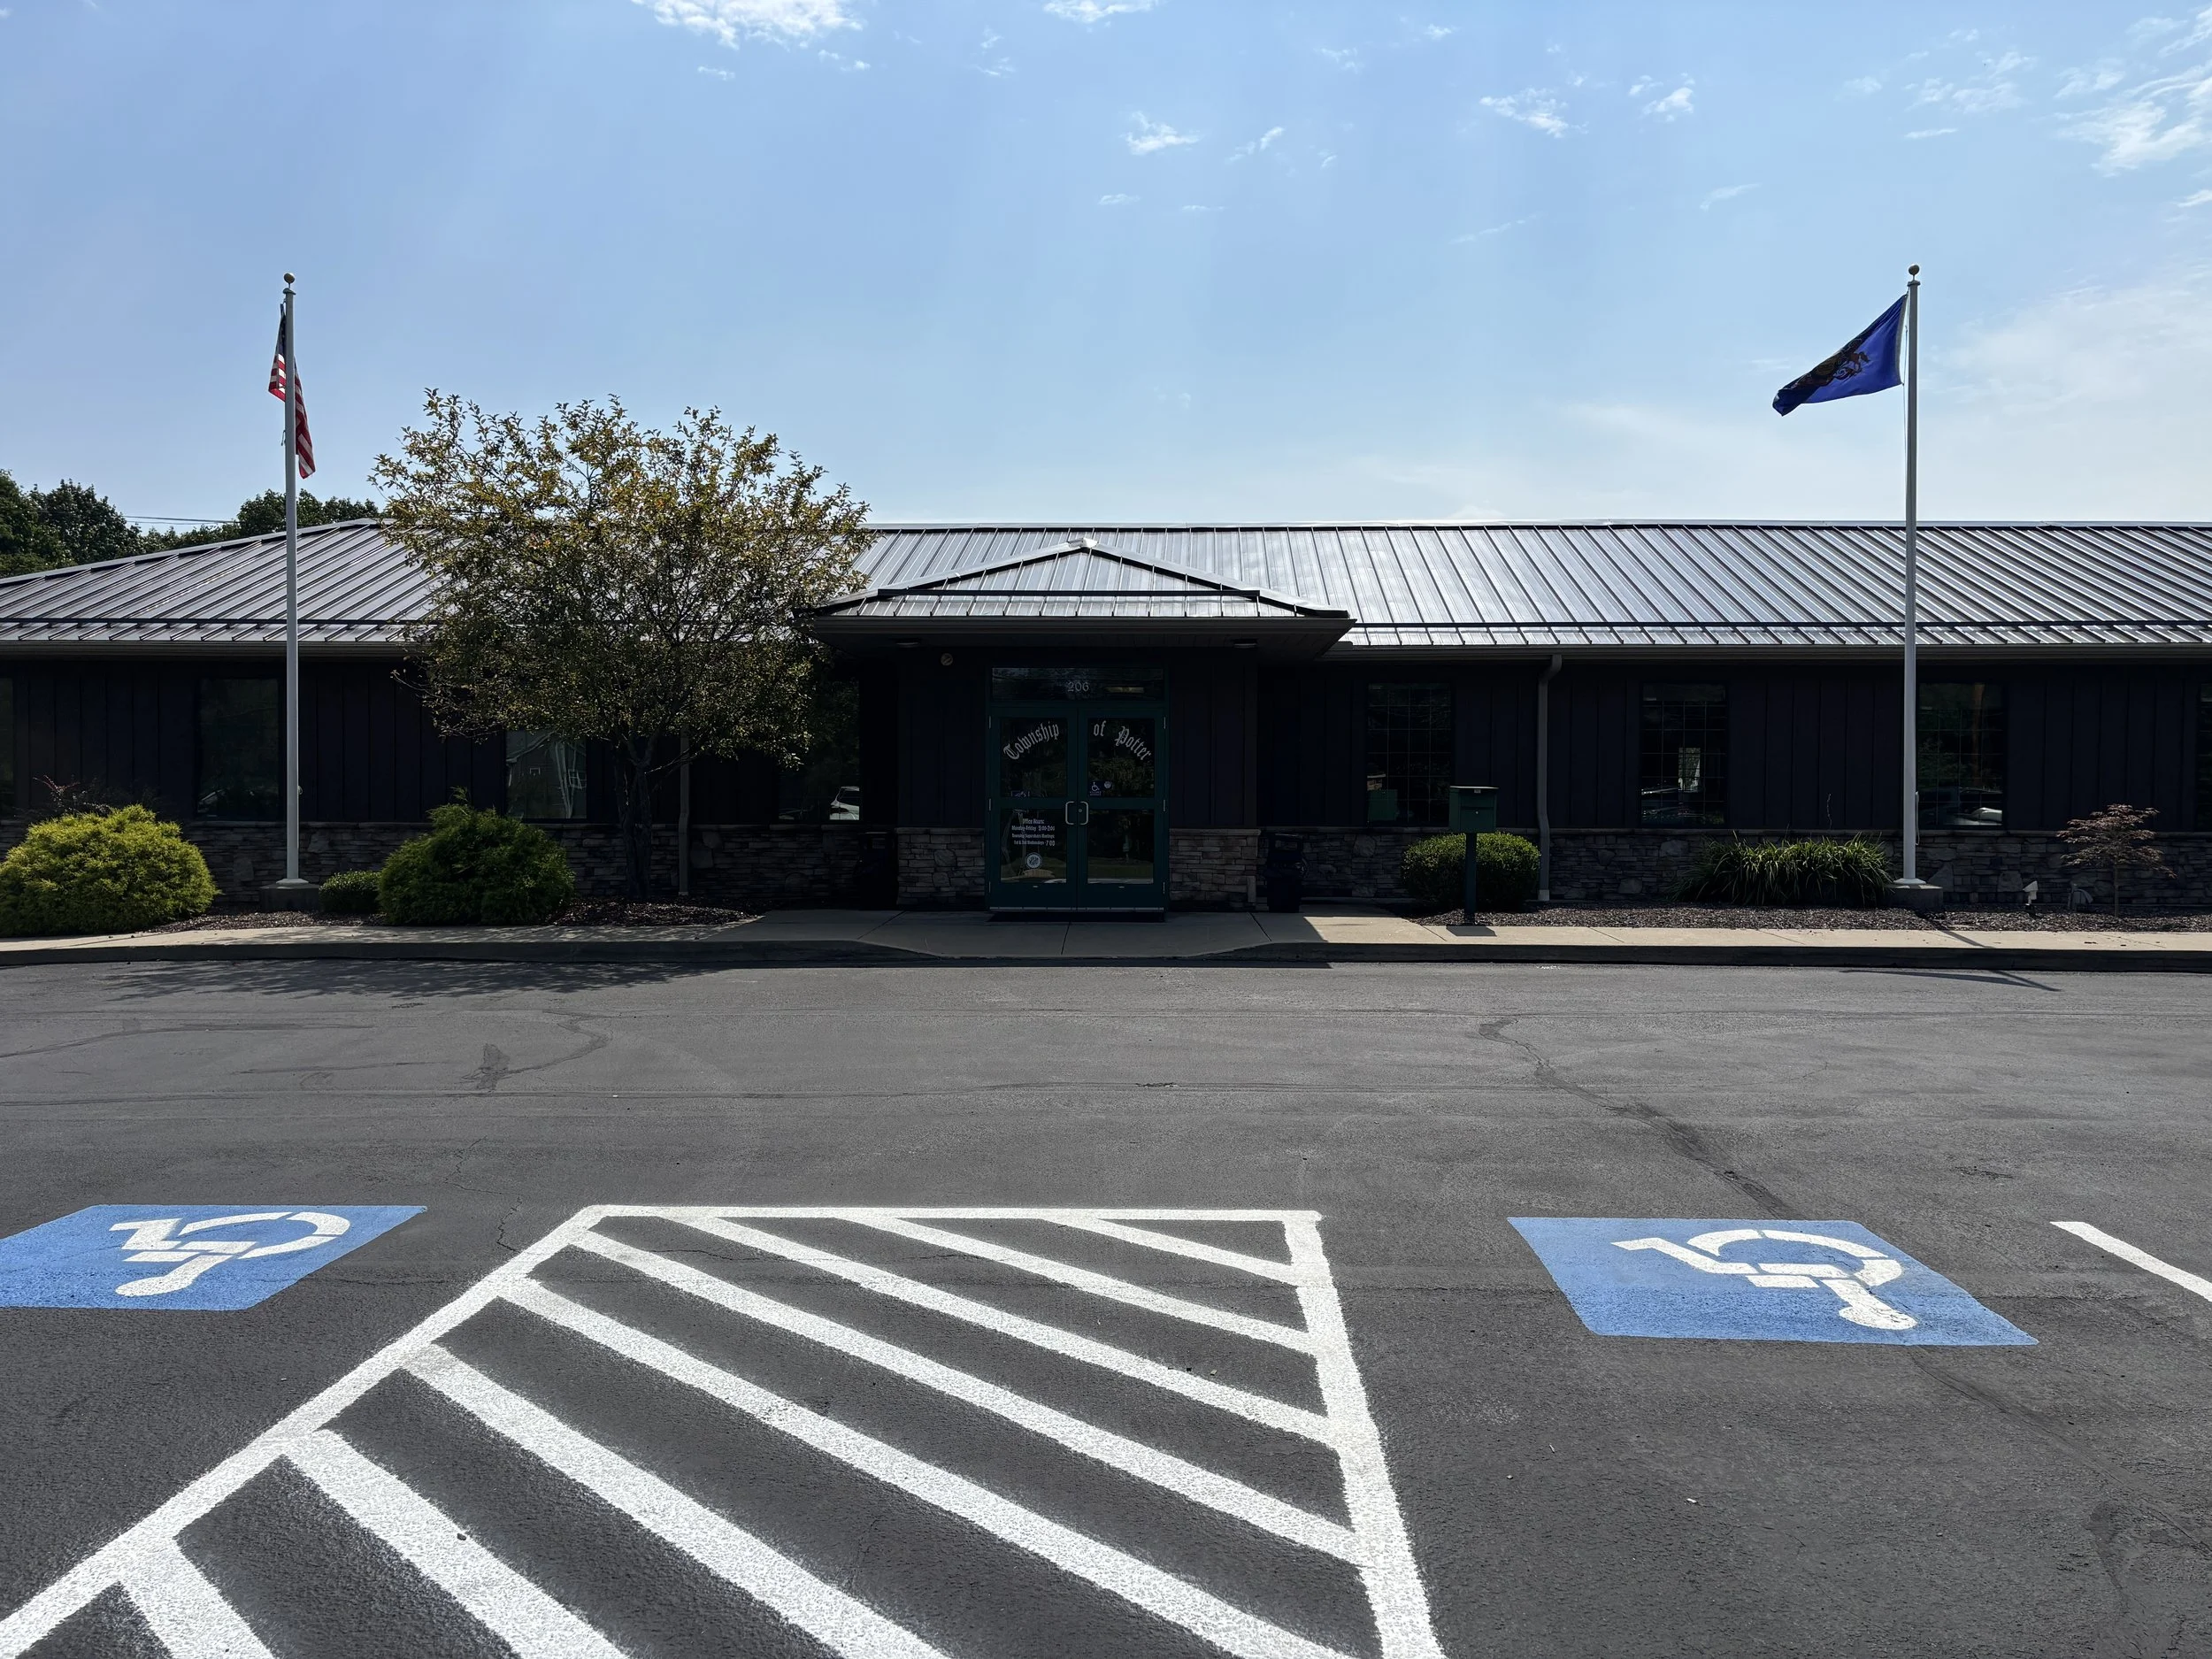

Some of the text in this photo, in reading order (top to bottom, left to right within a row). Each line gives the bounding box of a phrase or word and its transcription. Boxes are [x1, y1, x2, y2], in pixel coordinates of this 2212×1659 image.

[1067, 681, 1089, 692] 206
[1002, 720, 1152, 761] Township of Potter
